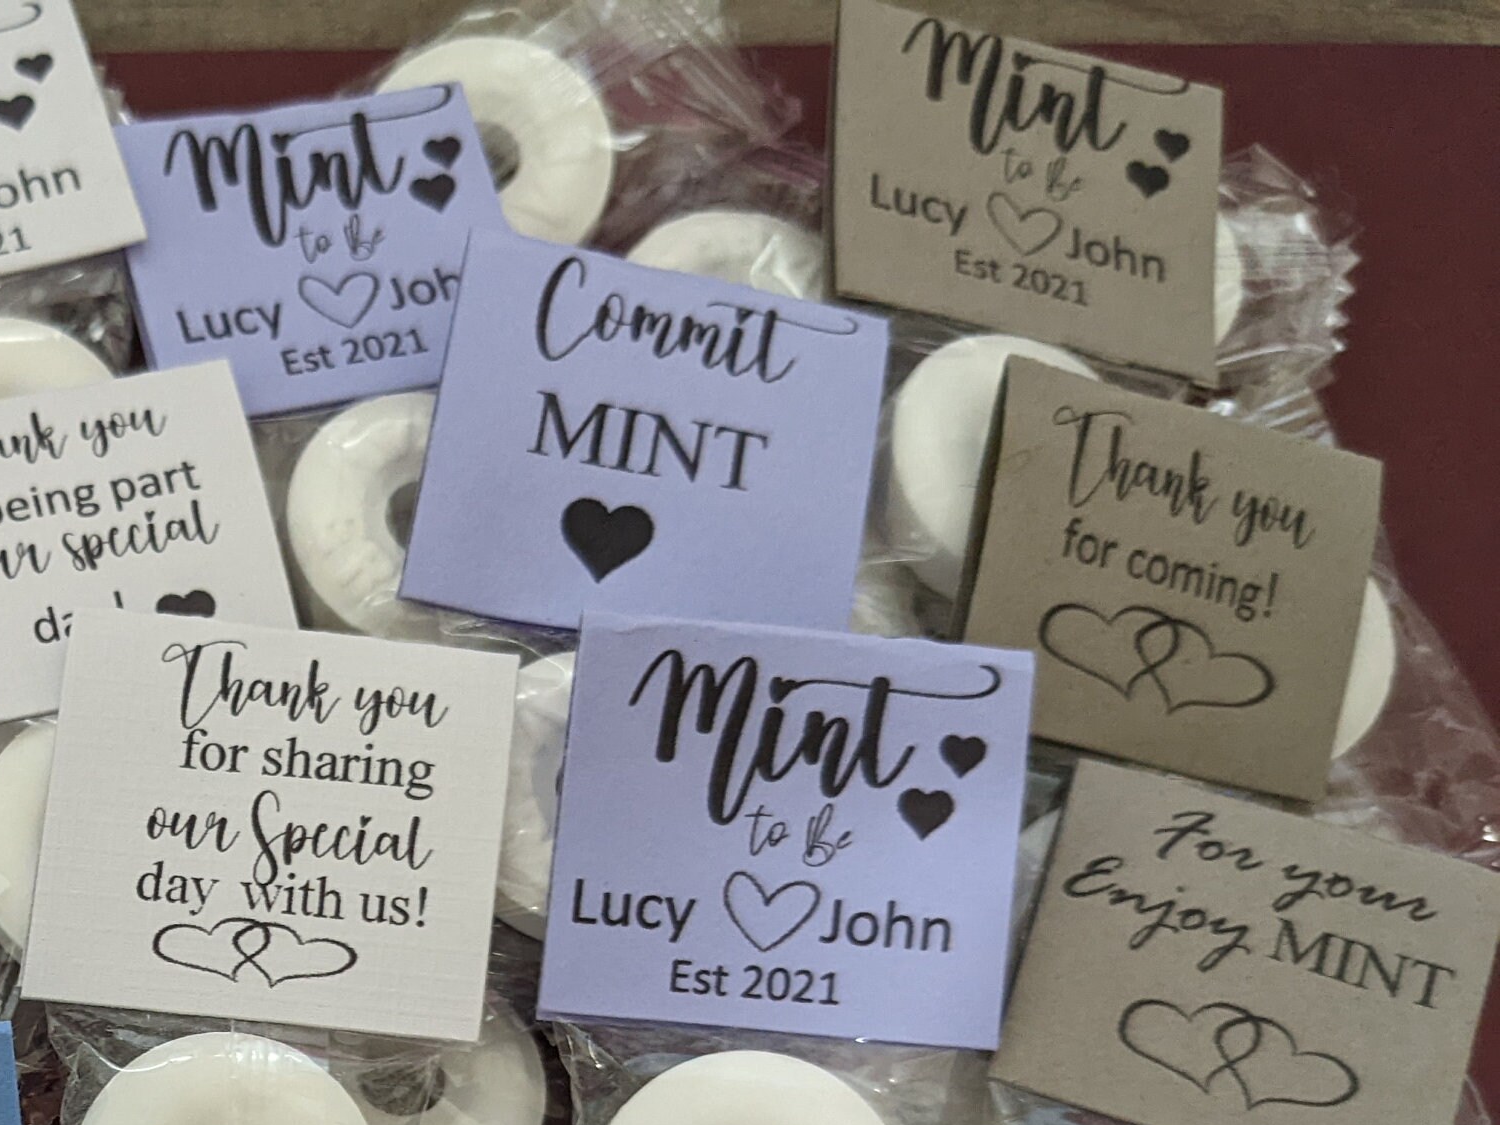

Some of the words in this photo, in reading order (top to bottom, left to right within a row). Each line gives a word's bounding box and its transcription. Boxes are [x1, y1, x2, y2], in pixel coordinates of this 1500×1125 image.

[902, 18, 1189, 155] Mint
[164, 84, 452, 247] Mint
[1000, 147, 1034, 184] to
[294, 225, 333, 264] to
[870, 172, 969, 236] Lucy
[1065, 227, 1166, 283] John
[176, 302, 282, 344] Lucy
[390, 267, 461, 311] Joh
[954, 248, 1003, 284] Est
[1012, 263, 1088, 307] 2021
[280, 345, 335, 376] Est
[341, 327, 429, 365] 2021
[536, 256, 858, 383] Commit
[80, 409, 166, 457] you
[527, 391, 768, 490] MINT
[109, 461, 201, 504] part
[1053, 405, 1219, 525] Thank
[1231, 490, 1315, 549] you
[62, 499, 219, 571] special
[1062, 517, 1120, 568] for
[1126, 549, 1279, 623] coming!
[162, 640, 340, 730] Thank
[354, 687, 448, 735] you
[180, 728, 249, 772] for
[262, 737, 435, 800] sharing
[629, 649, 1002, 826] Mint
[147, 807, 240, 852] our
[251, 790, 433, 887] Special
[745, 805, 790, 856] to
[1154, 811, 1264, 871] For
[1271, 864, 1438, 922] your
[136, 861, 219, 916] day
[240, 872, 344, 920] with
[360, 886, 428, 927] us!
[572, 878, 697, 943] Lucy
[819, 899, 951, 952] John
[1062, 855, 1253, 973] Enjoy
[1267, 918, 1457, 1009] MINT
[670, 959, 730, 997] Est
[741, 965, 840, 1005] 2021
